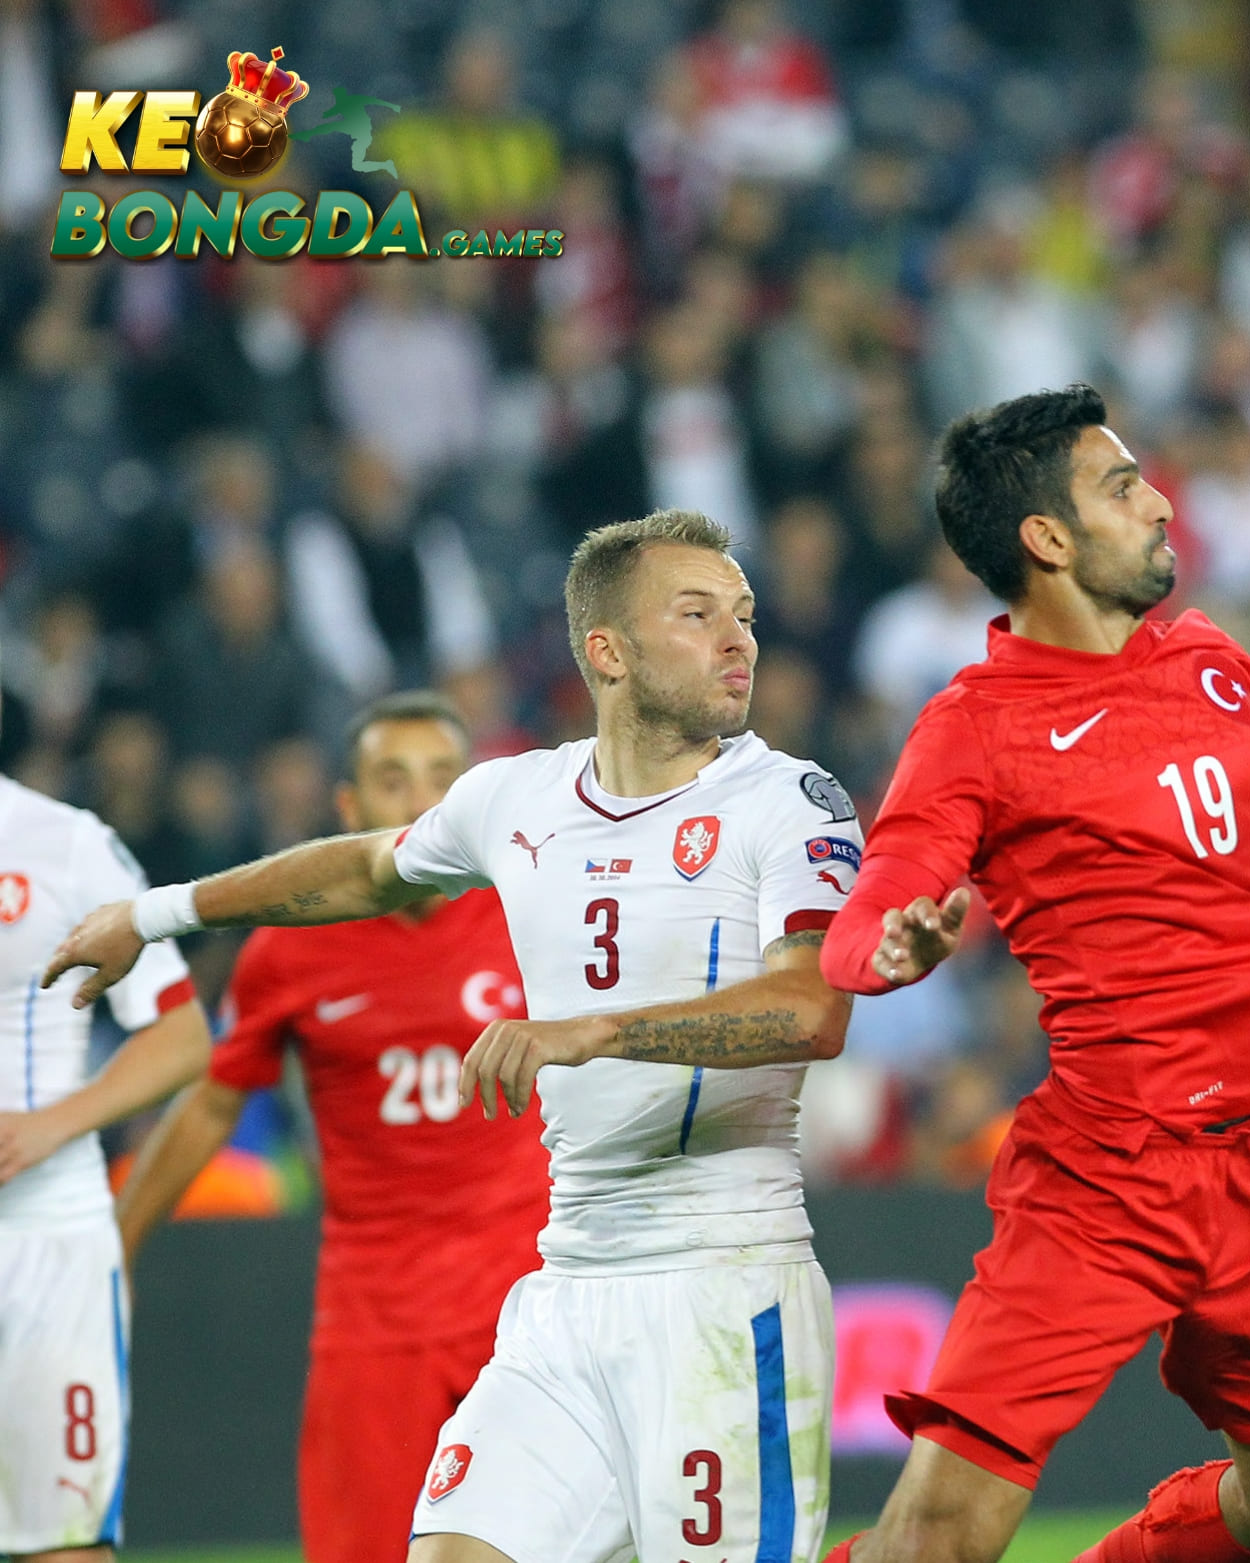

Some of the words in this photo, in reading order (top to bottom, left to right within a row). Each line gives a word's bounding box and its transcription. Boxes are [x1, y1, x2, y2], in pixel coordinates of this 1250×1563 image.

[1157, 755, 1238, 858] 19
[832, 843, 861, 866] RES
[584, 897, 620, 990] 3
[378, 1046, 463, 1126] 20
[65, 1383, 97, 1462] 8
[681, 1449, 723, 1547] 3
